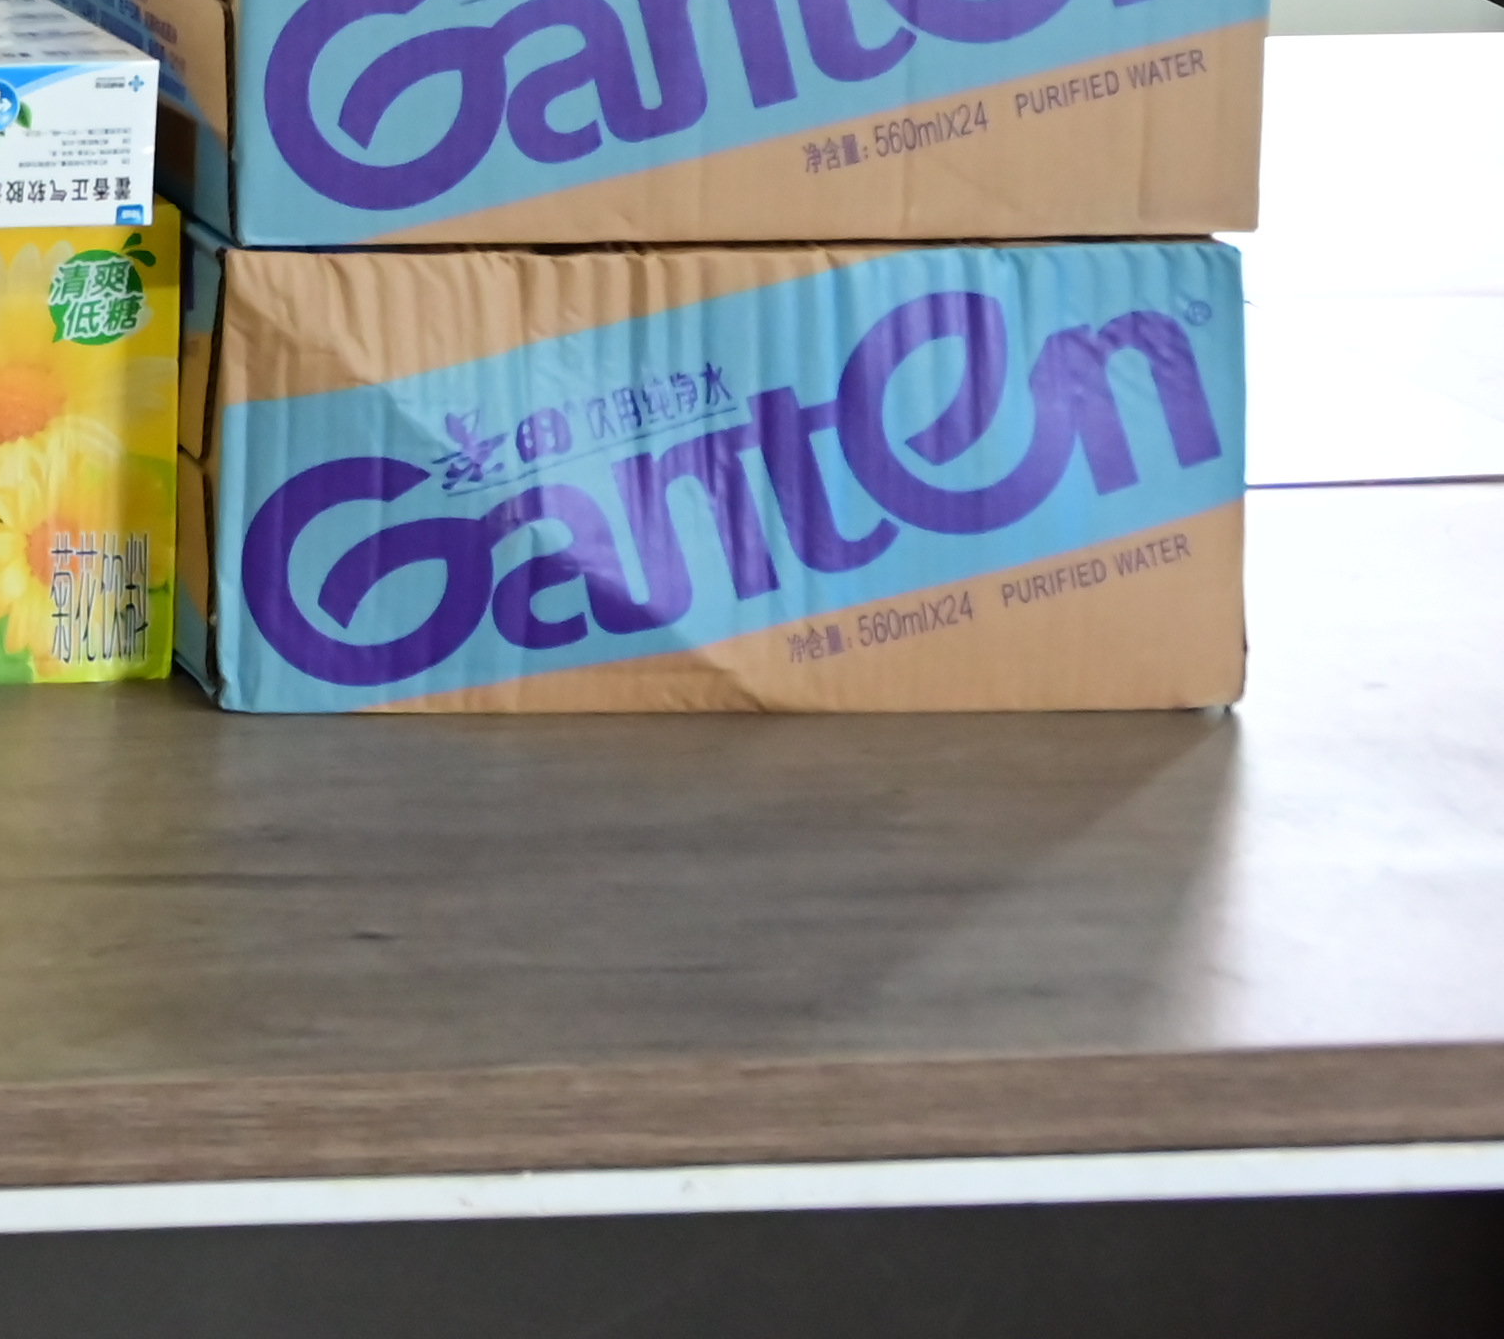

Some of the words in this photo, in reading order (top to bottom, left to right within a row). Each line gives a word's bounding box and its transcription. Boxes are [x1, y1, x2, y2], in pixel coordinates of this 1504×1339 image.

[1015, 69, 1123, 120] PURIFIED
[1128, 48, 1206, 91] WATER
[50, 259, 129, 301] 清爽
[63, 295, 145, 339] 低糖
[242, 291, 1220, 688] Ganten
[50, 533, 149, 664] 菊花饮料
[1001, 554, 1109, 610] PURIFIED
[1114, 532, 1190, 579] WATER
